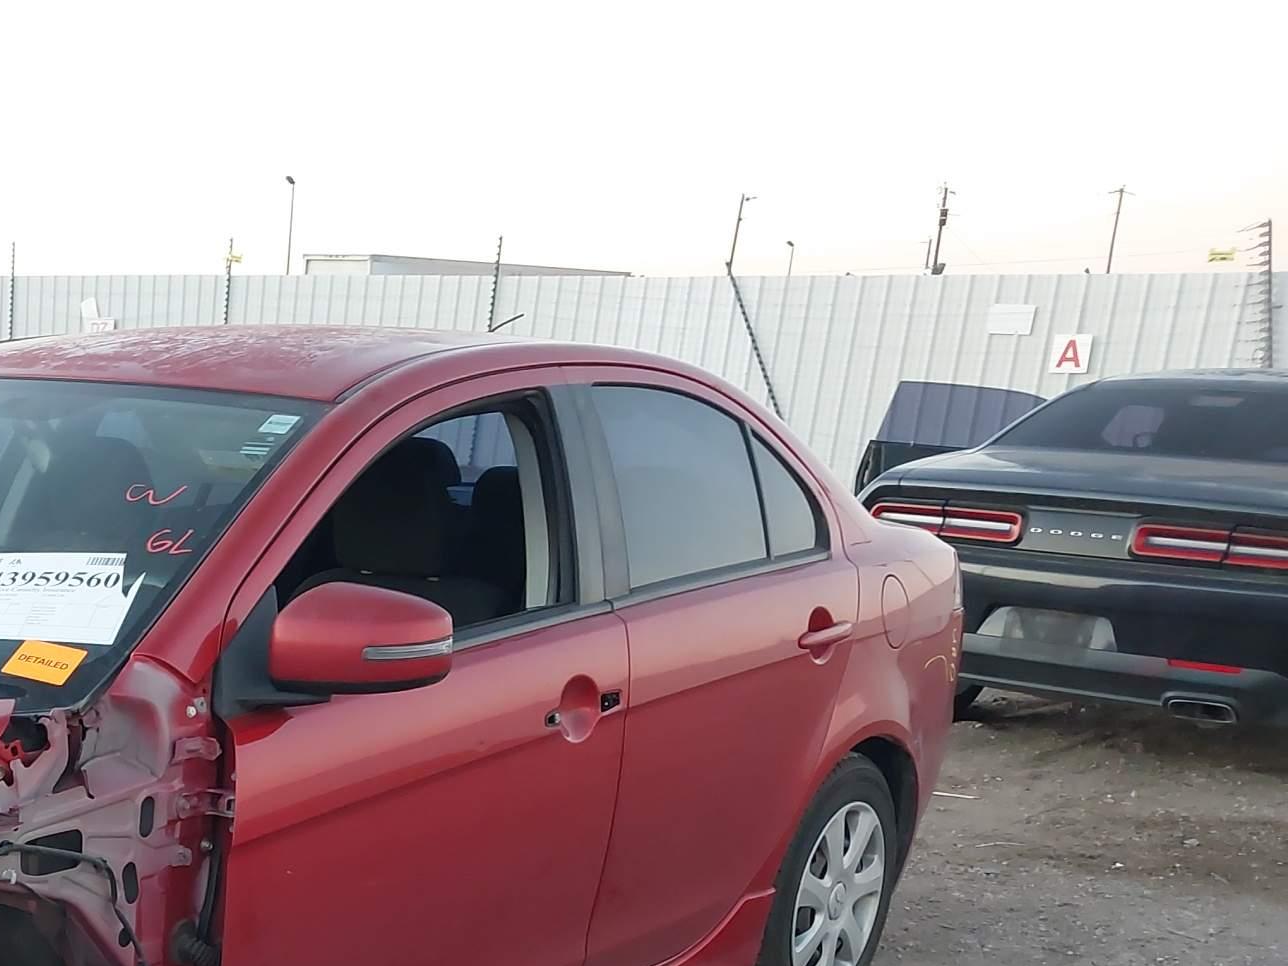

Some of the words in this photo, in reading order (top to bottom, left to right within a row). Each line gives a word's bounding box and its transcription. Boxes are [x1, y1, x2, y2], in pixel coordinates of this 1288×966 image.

[1055, 339, 1081, 368] A
[1029, 527, 1124, 541] DODGE
[17, 653, 70, 671] DETAILED
